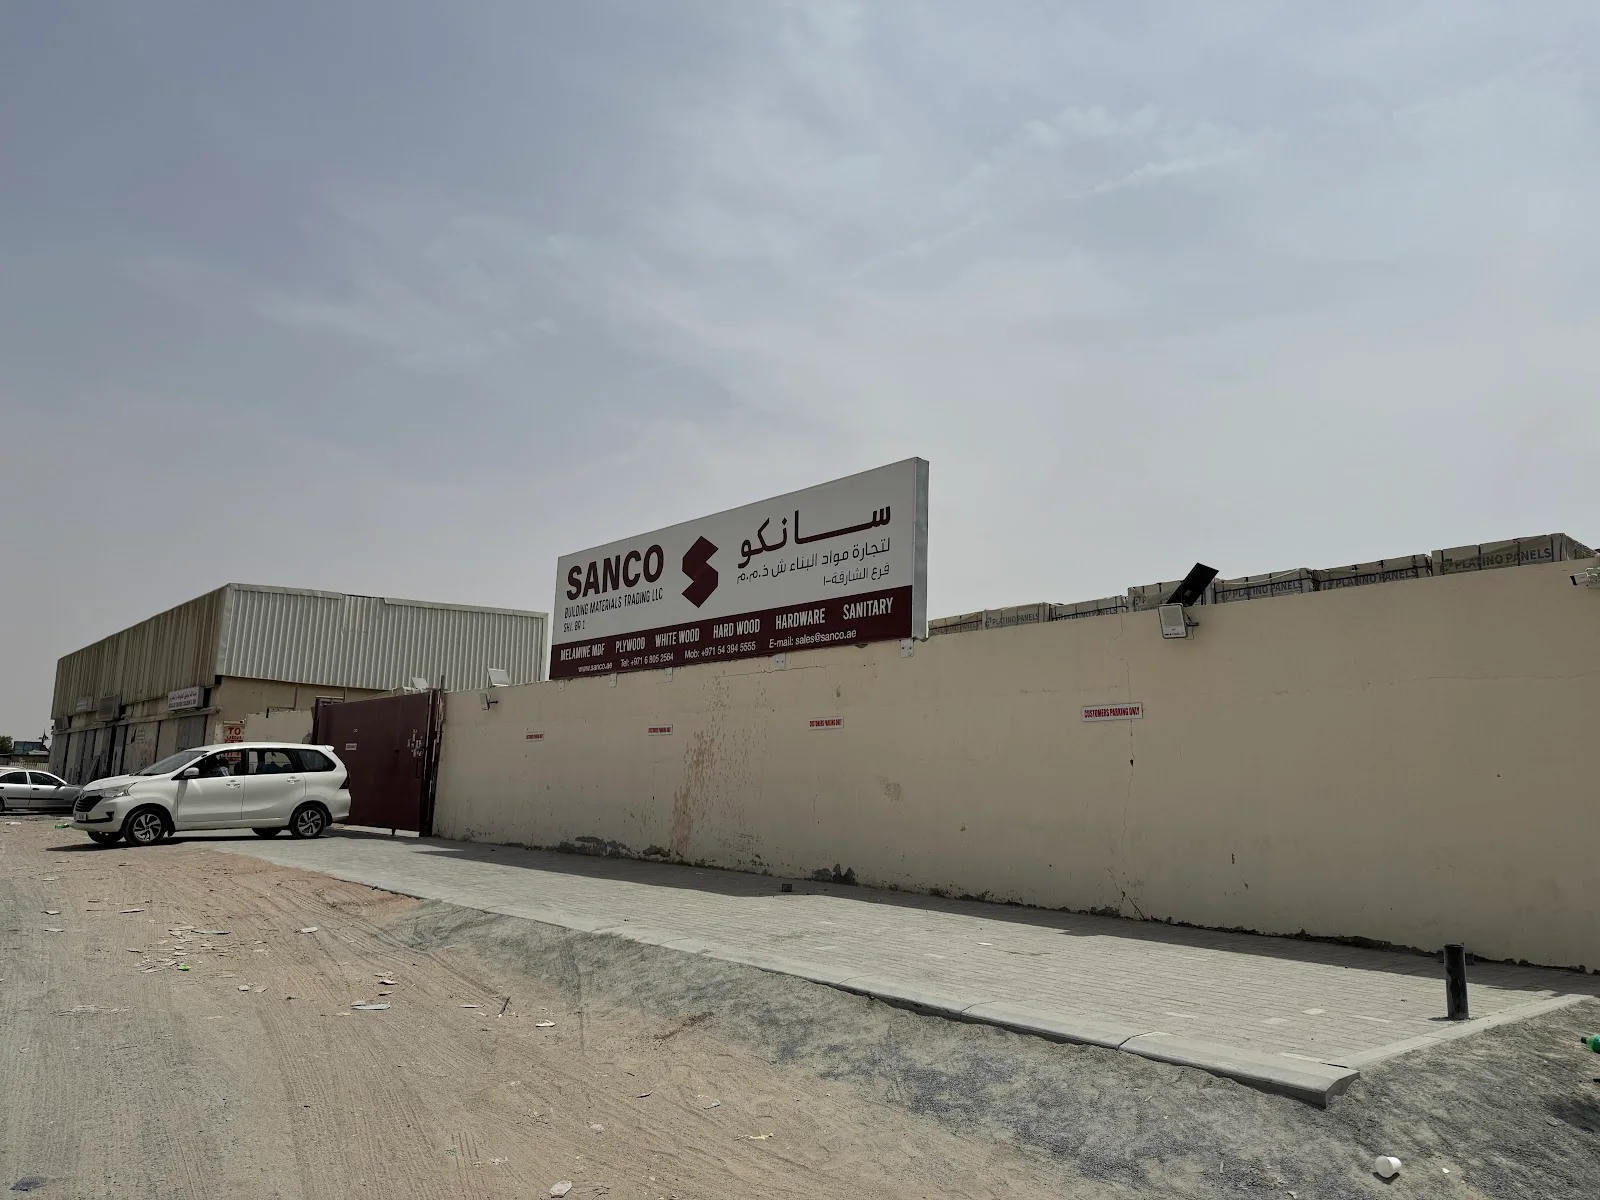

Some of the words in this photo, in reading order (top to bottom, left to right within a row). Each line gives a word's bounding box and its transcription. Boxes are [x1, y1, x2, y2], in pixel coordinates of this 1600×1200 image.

[821, 549, 849, 567] مواد
[852, 537, 891, 562] لتجارة
[1505, 547, 1552, 563] PANELS
[771, 558, 787, 578] ش
[789, 552, 818, 572] البناء
[870, 561, 890, 581] فرع
[566, 544, 664, 601] SANCO
[1271, 580, 1303, 592] PANELS
[564, 603, 589, 619] BUILDING
[589, 596, 622, 614] MATERIALS
[624, 590, 650, 607] TRADING
[652, 587, 663, 601] LLC
[560, 645, 591, 661] MELAMINE
[592, 642, 606, 657] MDF
[615, 636, 646, 654] PLYWOOD
[654, 631, 677, 648] WHITE
[678, 628, 700, 644] WOOD
[712, 622, 734, 639] HARD
[736, 618, 761, 636] WOOD
[775, 607, 826, 630] HARDWARE
[842, 596, 894, 620] SANITARY
[578, 662, 613, 673] www.sanco.ae
[620, 658, 630, 668] Tel:
[630, 656, 643, 667] +971
[684, 649, 700, 660] Mob:
[701, 646, 716, 657] +971
[717, 645, 726, 655] 54
[726, 643, 739, 654] 394
[739, 641, 757, 652] 5555
[768, 636, 794, 649] E-mail:
[795, 629, 857, 646] sales@sanco.ae
[227, 727, 241, 736] TO
